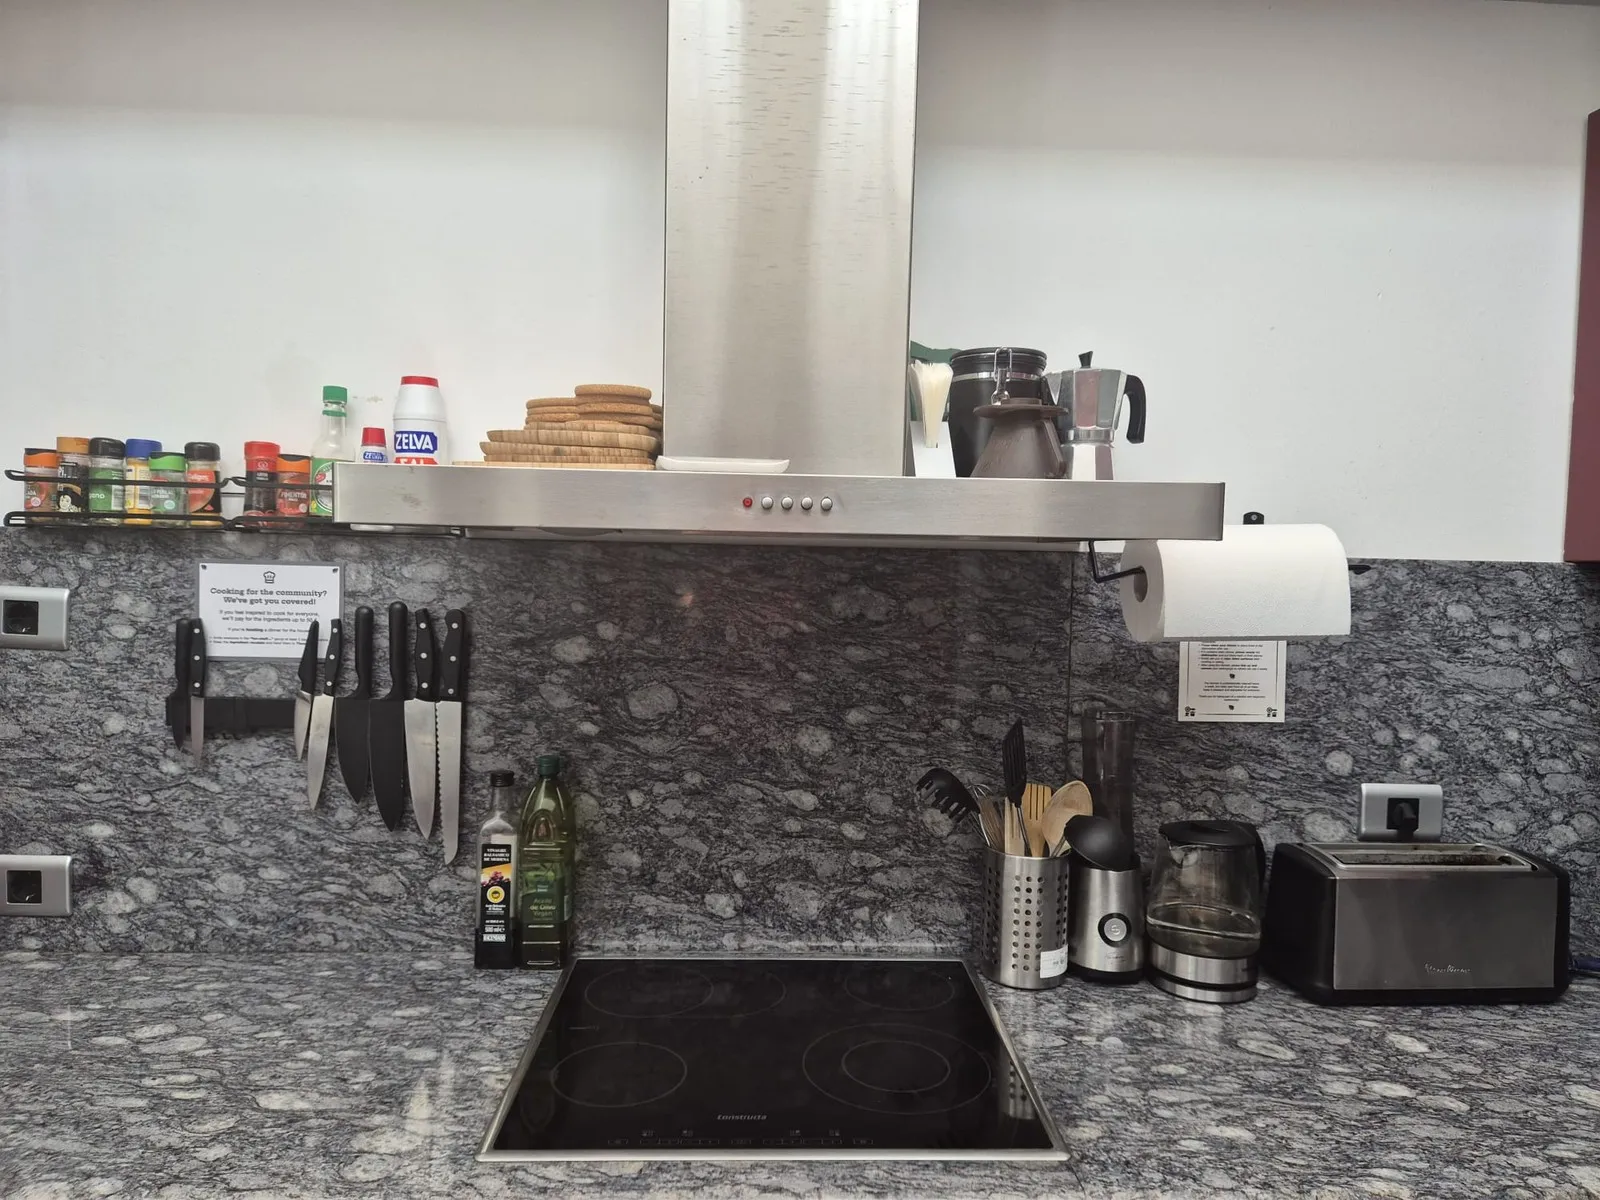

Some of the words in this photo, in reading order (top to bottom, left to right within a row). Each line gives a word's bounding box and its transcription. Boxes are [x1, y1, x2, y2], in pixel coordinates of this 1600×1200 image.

[396, 433, 433, 451] ZELVA
[210, 587, 244, 596] Cooking
[246, 588, 259, 596] for
[223, 596, 248, 604] We've
